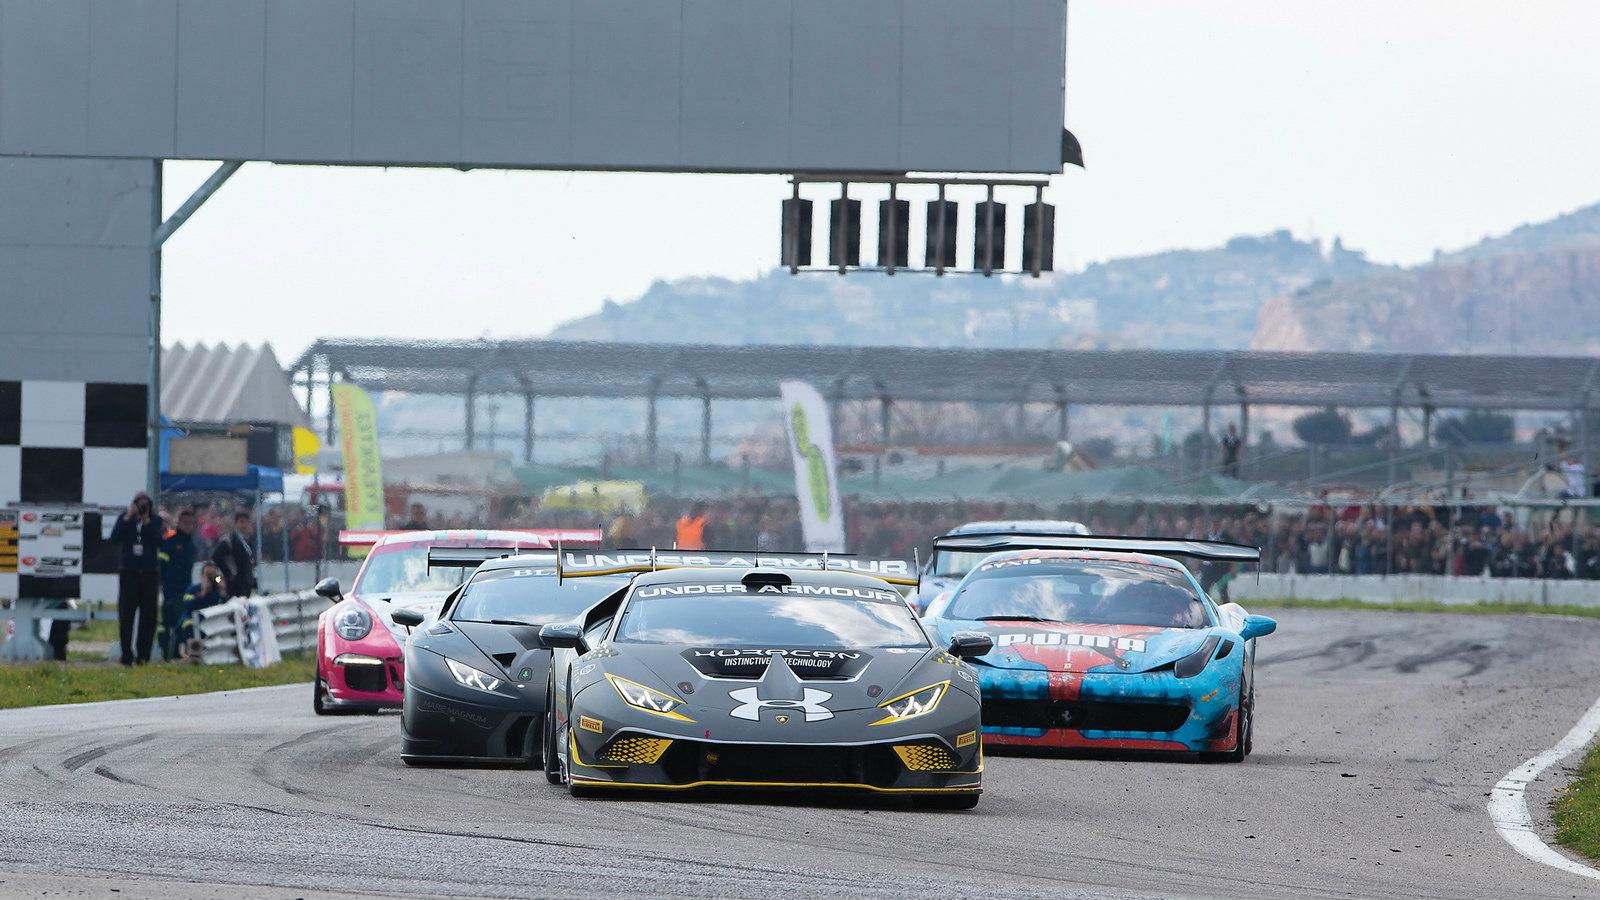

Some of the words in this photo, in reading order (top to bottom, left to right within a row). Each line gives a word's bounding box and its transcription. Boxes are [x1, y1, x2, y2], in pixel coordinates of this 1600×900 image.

[566, 553, 711, 567] UNDER
[721, 556, 908, 575] ARMOUR
[638, 585, 747, 598] UNDER
[758, 584, 897, 602] ARMOUR
[998, 633, 1147, 653] PUMA
[724, 656, 772, 667] INSTINCTIVE
[784, 657, 833, 668] TECHNOLOGY
